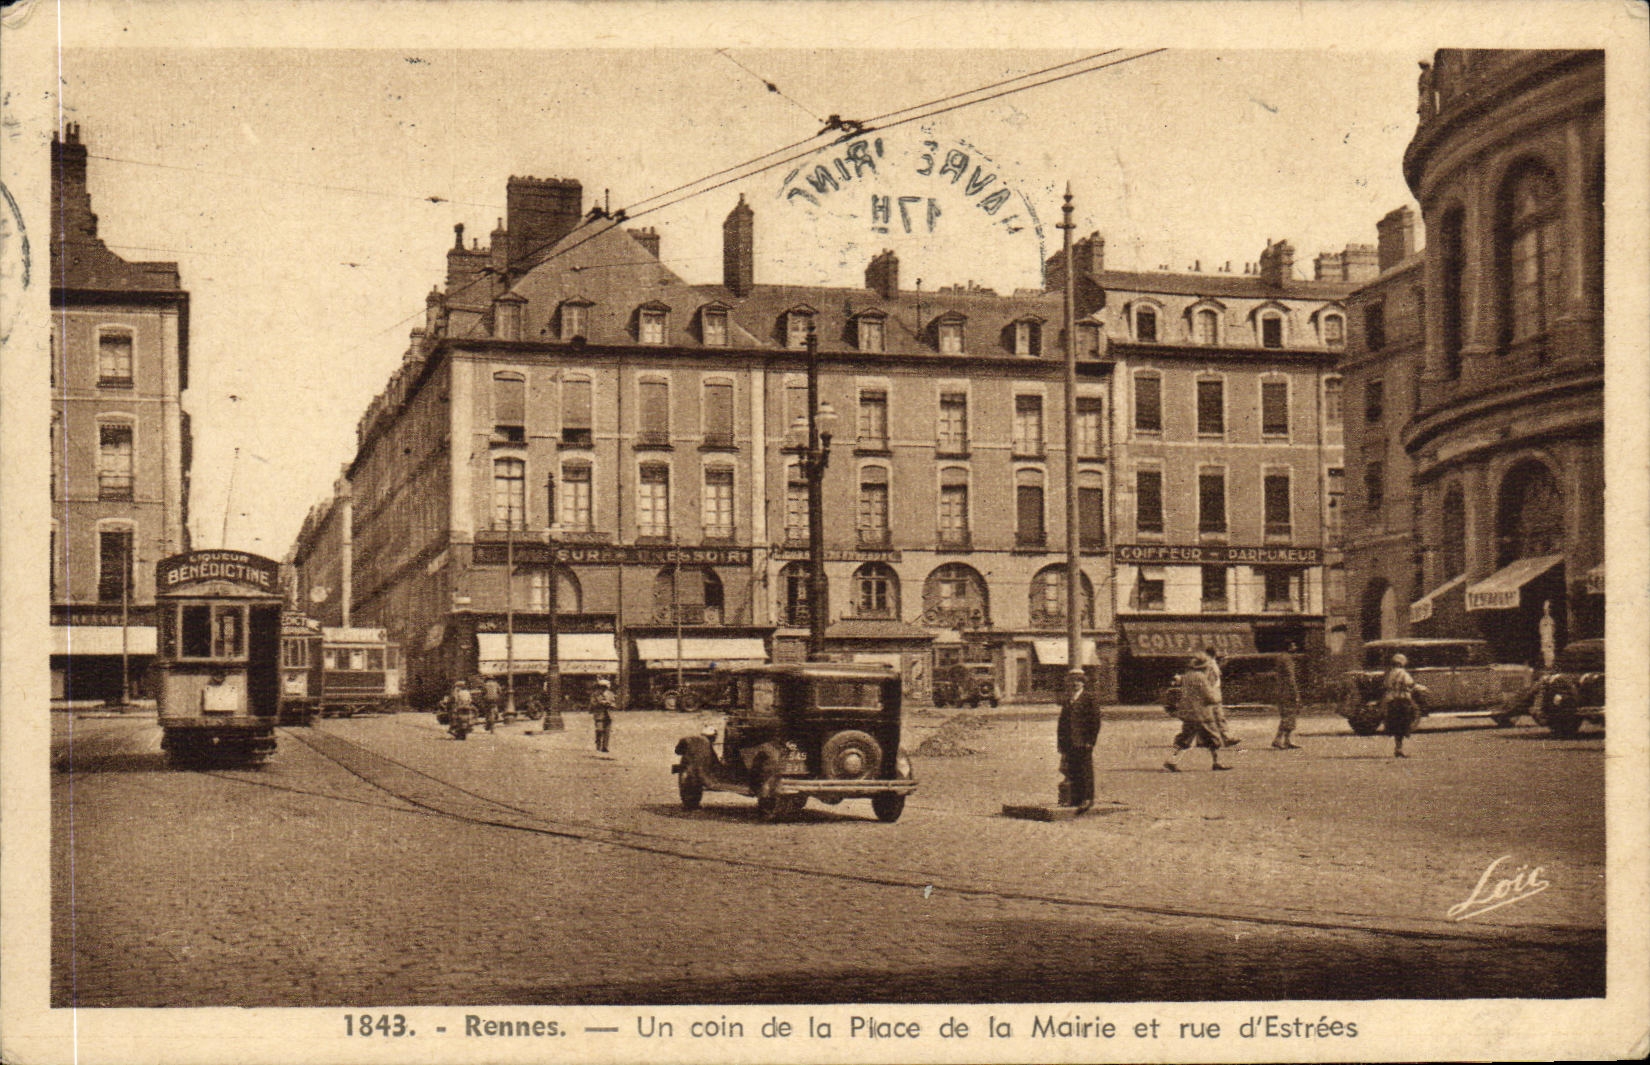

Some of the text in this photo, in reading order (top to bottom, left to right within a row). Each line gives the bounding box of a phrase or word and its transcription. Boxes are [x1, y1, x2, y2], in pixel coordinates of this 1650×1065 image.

[189, 553, 249, 562] LIQUEUR
[1120, 547, 1200, 560] COIFFEUR
[1228, 549, 1316, 561] PARFUMEUR
[1137, 633, 1245, 649] COIFFEUR
